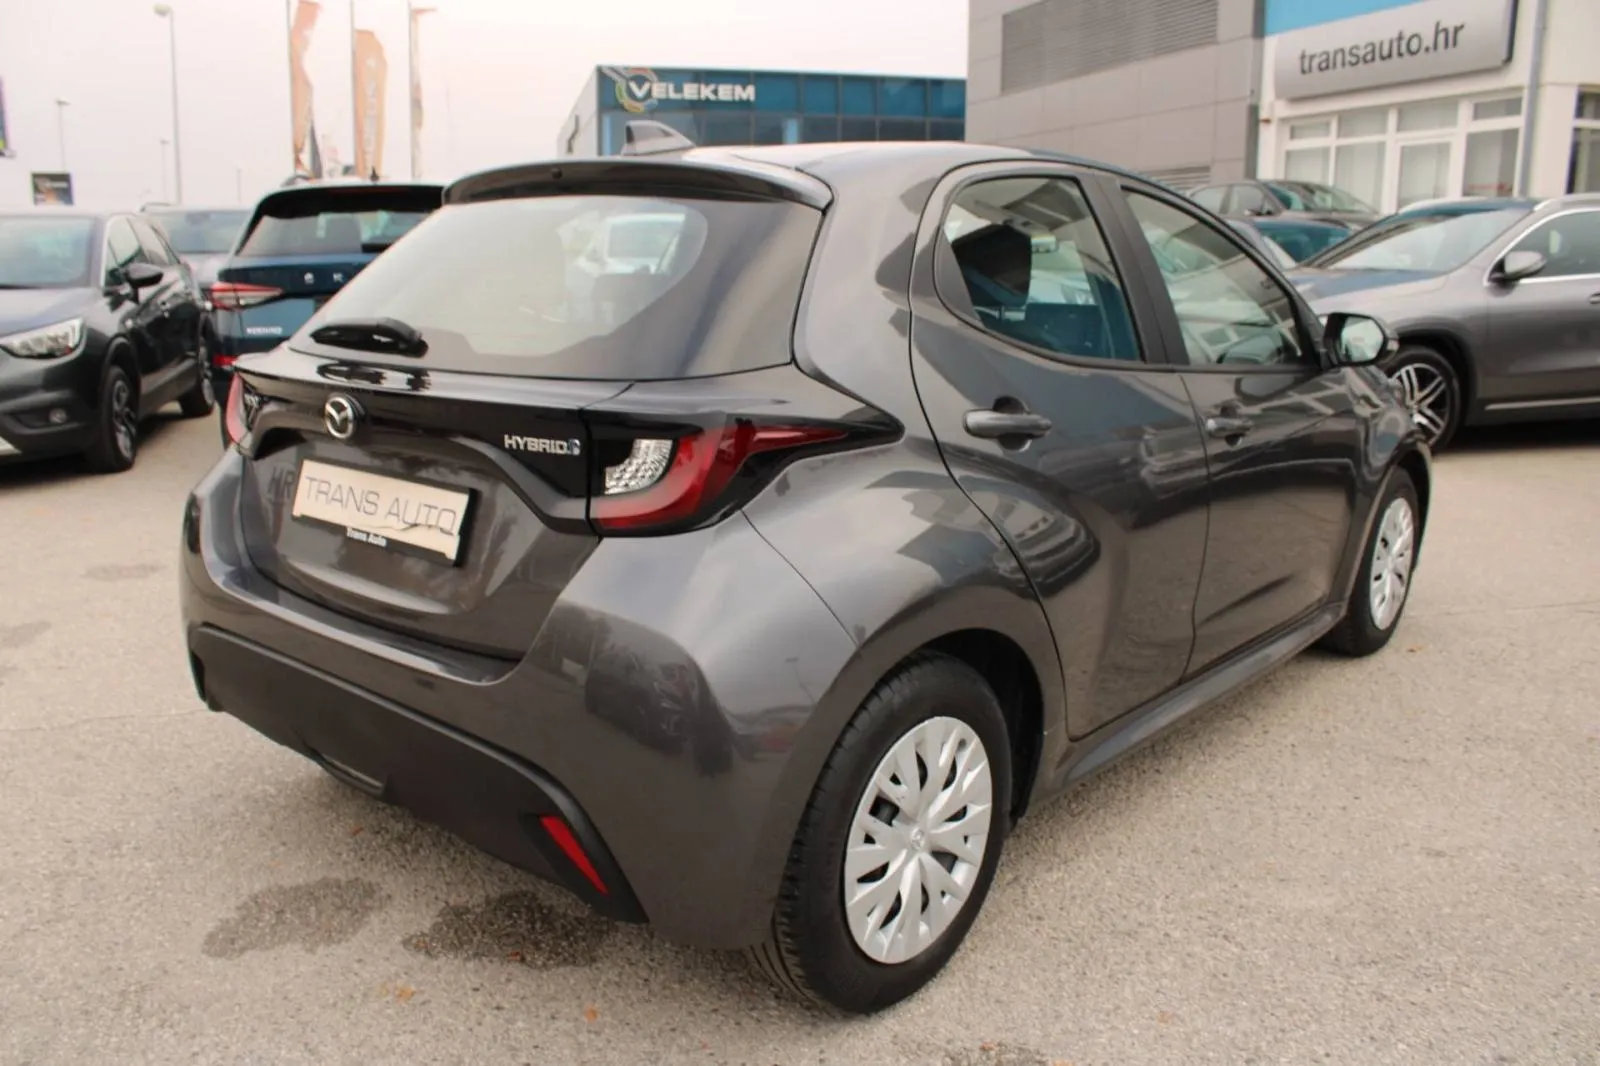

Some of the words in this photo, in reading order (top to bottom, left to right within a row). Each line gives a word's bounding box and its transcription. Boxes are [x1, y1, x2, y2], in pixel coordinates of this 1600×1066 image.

[1299, 21, 1465, 74] transauto.hr
[628, 81, 756, 102] VELEKEM
[305, 475, 381, 516] TRANS
